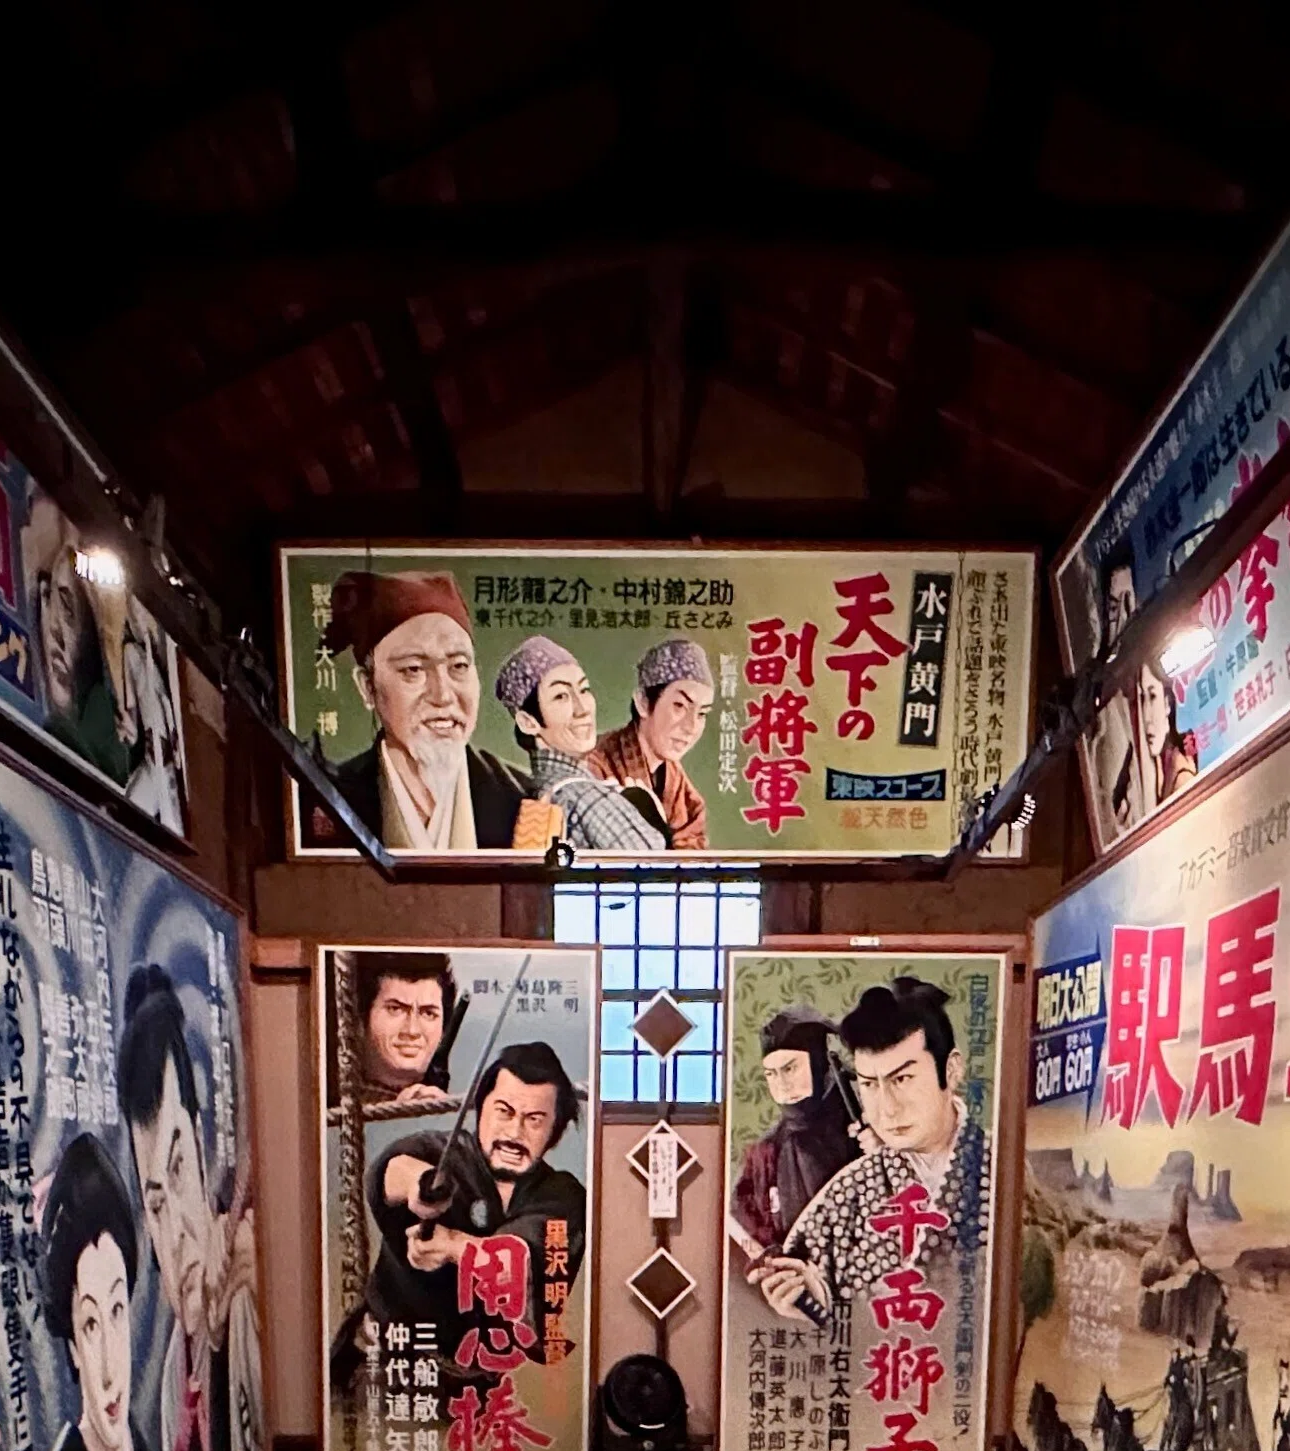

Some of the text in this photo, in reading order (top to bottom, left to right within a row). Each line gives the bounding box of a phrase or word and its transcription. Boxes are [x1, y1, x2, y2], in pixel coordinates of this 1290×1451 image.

[474, 575, 735, 606] 月形龍之介・中村錦之助
[825, 570, 910, 742] 天下の
[903, 581, 947, 738] 水戸黄門
[740, 614, 819, 836] 副将軍
[831, 774, 942, 799] 東映スコープ
[1036, 1046, 1093, 1099] 80円 60円
[808, 1326, 827, 1451] 千原しのぶ
[828, 1297, 853, 1451] 市川右太衛門
